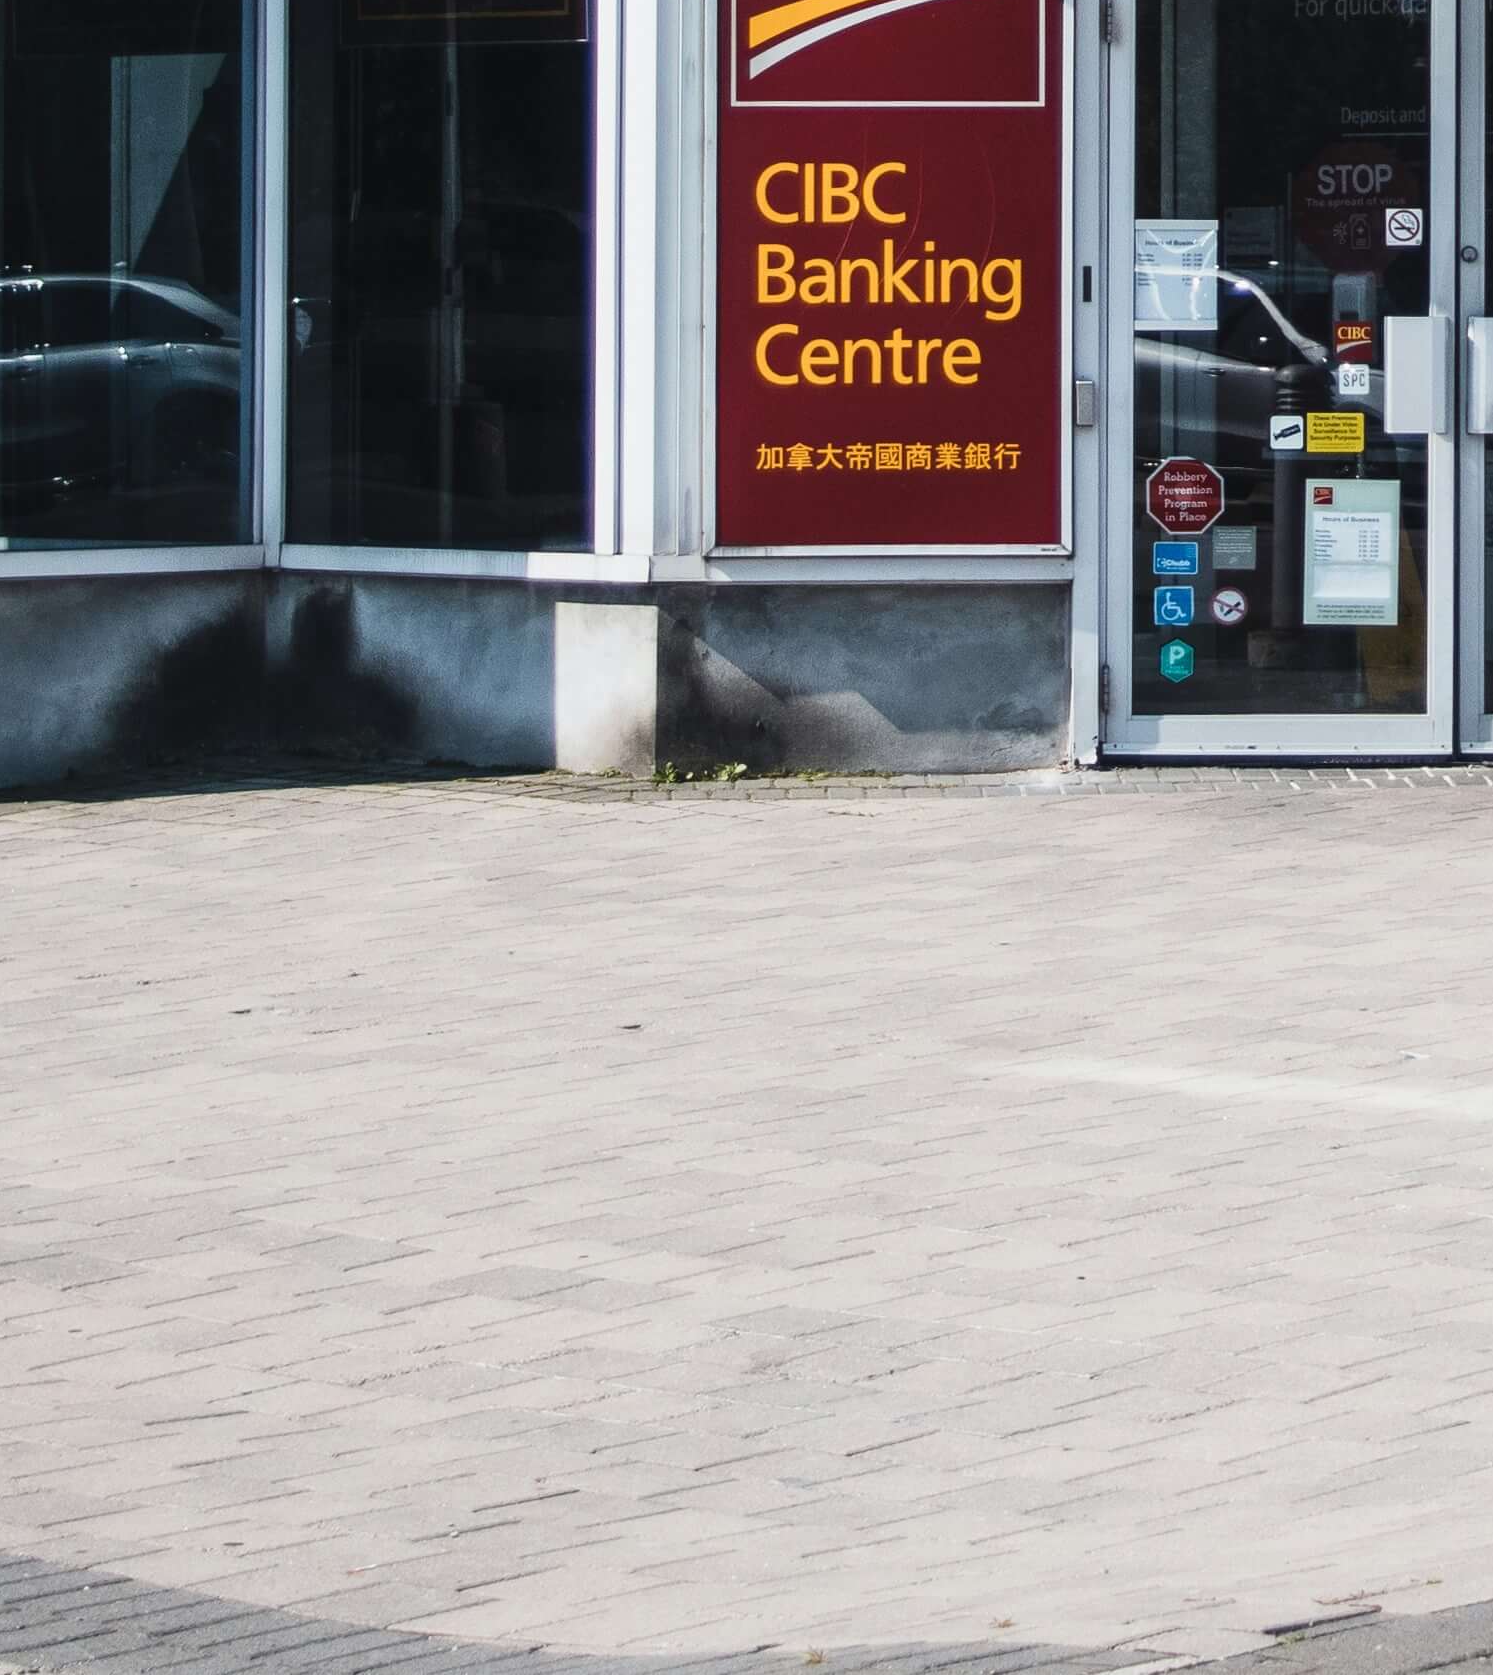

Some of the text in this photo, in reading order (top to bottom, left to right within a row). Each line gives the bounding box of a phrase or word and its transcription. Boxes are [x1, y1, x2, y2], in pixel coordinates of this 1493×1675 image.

[1341, 105, 1426, 126] Deposit and
[1317, 164, 1393, 194] STOP
[756, 162, 907, 223] CIBC
[1305, 197, 1406, 209] The spread of virus
[757, 239, 1022, 321] Banking
[1338, 326, 1371, 339] CIBC
[756, 323, 982, 385] Centre
[1343, 373, 1365, 387] SPC
[756, 442, 1022, 471] 加拿大帝國商業銀行
[1164, 471, 1207, 483] Robbery
[1158, 484, 1213, 495] Prevention
[1164, 498, 1207, 510] Program
[1165, 511, 1207, 521] in Place
